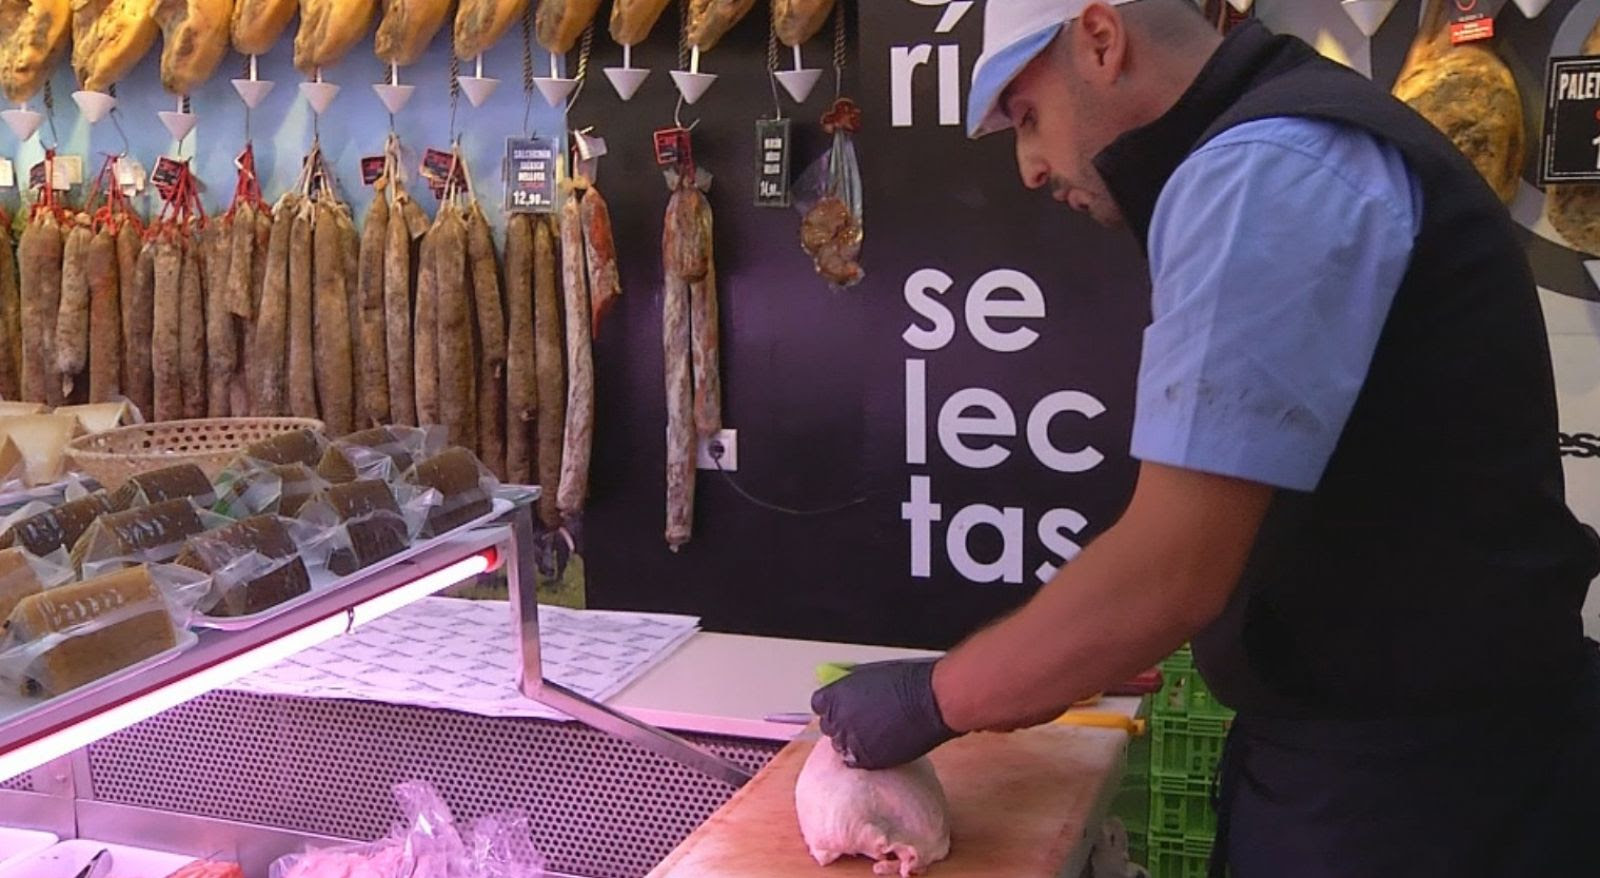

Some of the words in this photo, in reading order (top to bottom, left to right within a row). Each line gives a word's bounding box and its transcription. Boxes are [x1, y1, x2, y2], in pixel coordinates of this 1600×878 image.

[901, 267, 1046, 352] se
[905, 358, 1107, 473] lec
[901, 474, 1089, 584] tas
